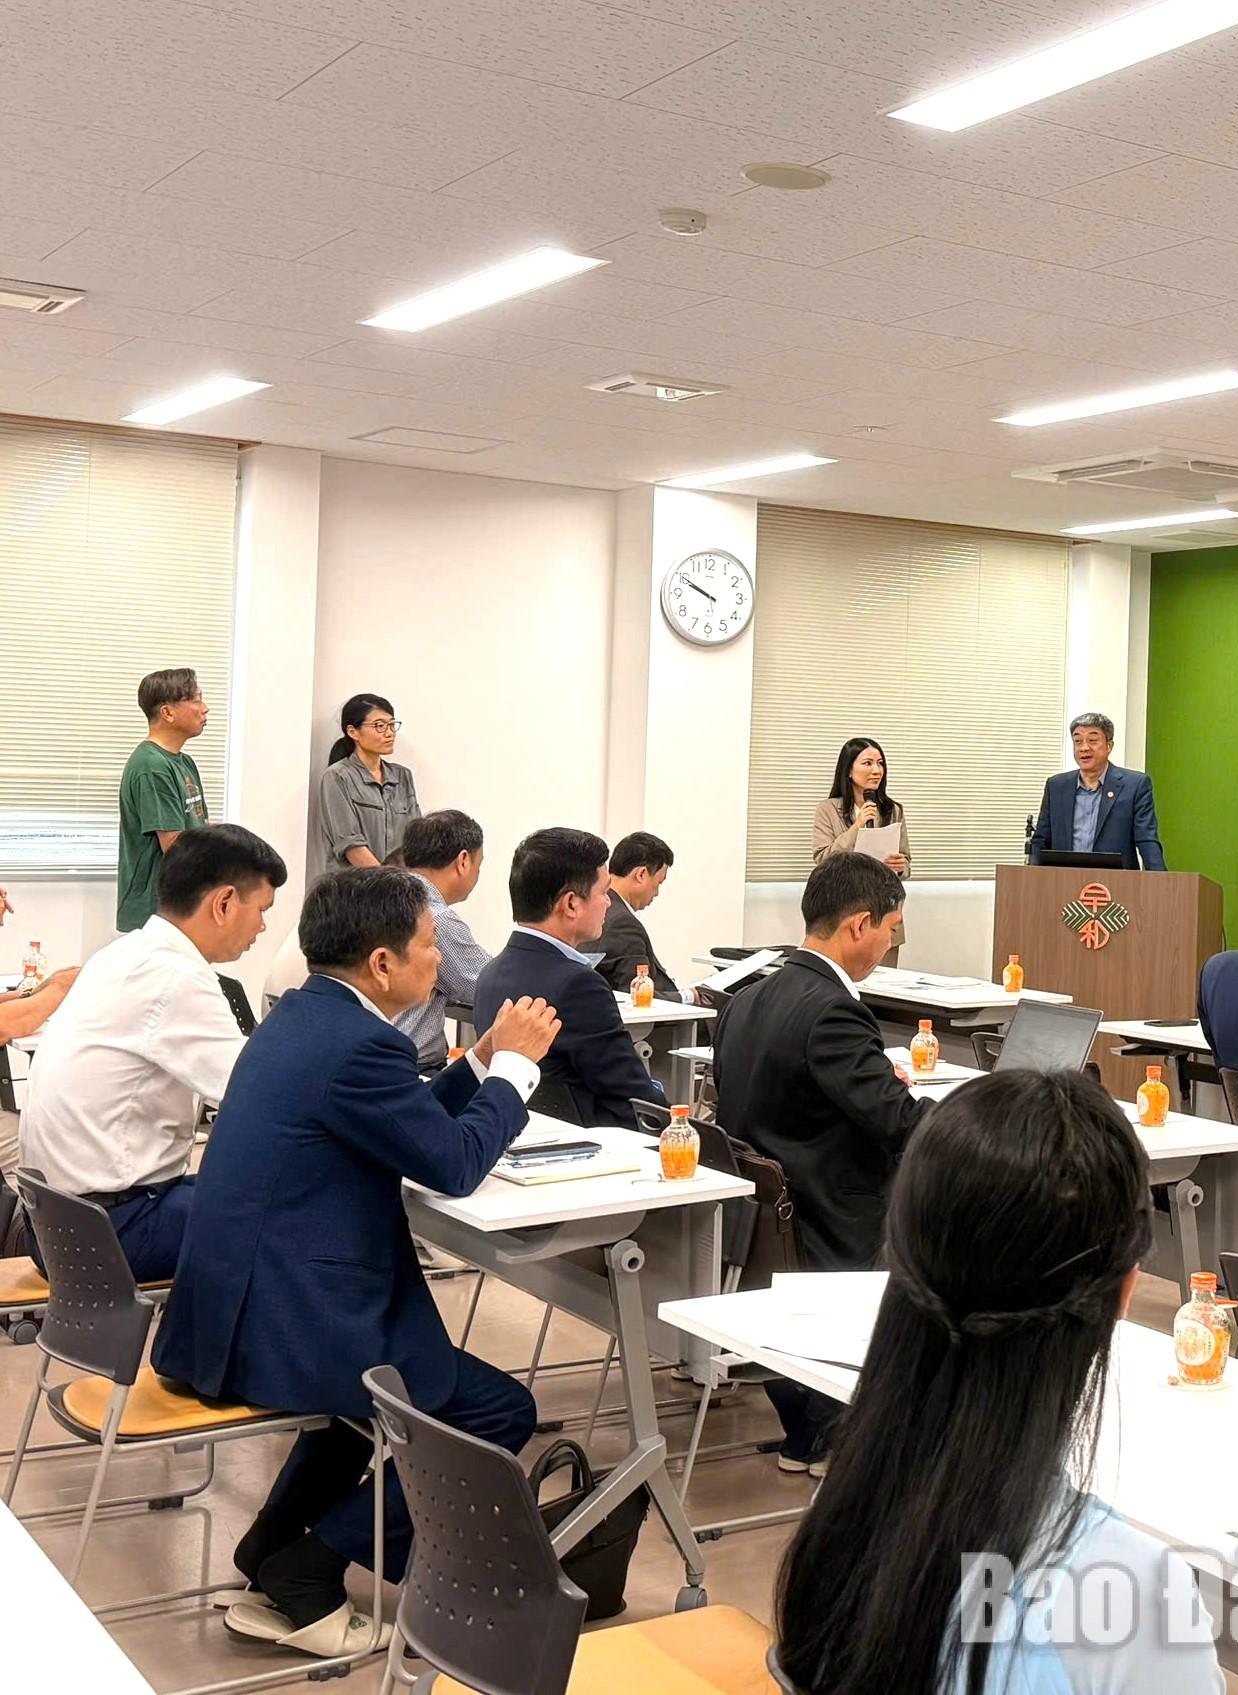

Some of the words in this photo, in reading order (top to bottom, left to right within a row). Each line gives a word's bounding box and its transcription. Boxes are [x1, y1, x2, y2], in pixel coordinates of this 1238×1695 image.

[692, 560, 701, 573] 11
[704, 558, 716, 571] 12
[679, 572, 690, 585] 10
[731, 576, 739, 588] 2
[673, 587, 683, 599] 9
[735, 592, 743, 605] 3
[678, 604, 687, 617] 8
[730, 610, 738, 620] 4
[691, 616, 699, 629] 7
[703, 622, 712, 634] 6
[718, 619, 728, 632] 5
